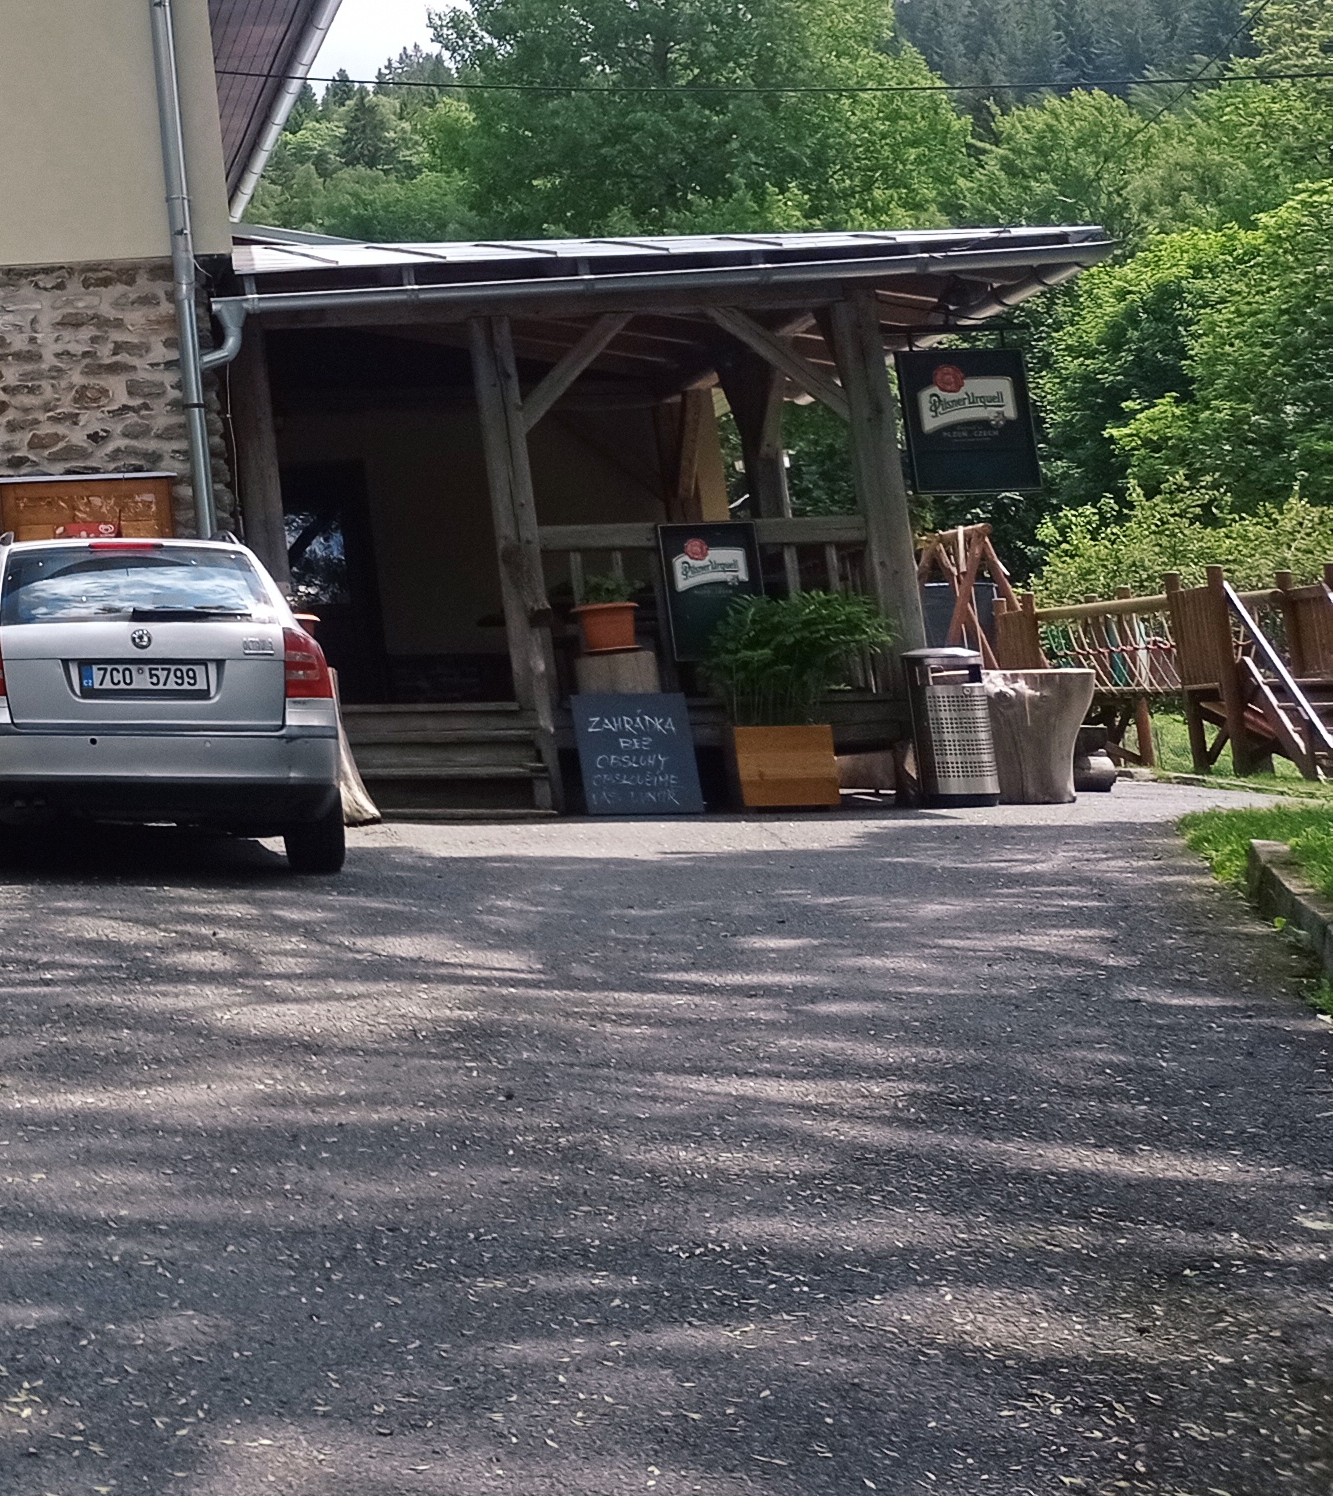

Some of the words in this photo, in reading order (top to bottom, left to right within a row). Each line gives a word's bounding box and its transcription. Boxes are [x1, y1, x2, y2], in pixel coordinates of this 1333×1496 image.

[929, 392, 967, 418] Pilsner
[965, 391, 1005, 409] Urquell
[681, 560, 710, 581] Pilsner
[148, 667, 197, 686] 5799
[587, 709, 677, 735] ZAHRÁDKA
[619, 736, 653, 750] BEZ
[596, 753, 670, 770] OBSLUHY
